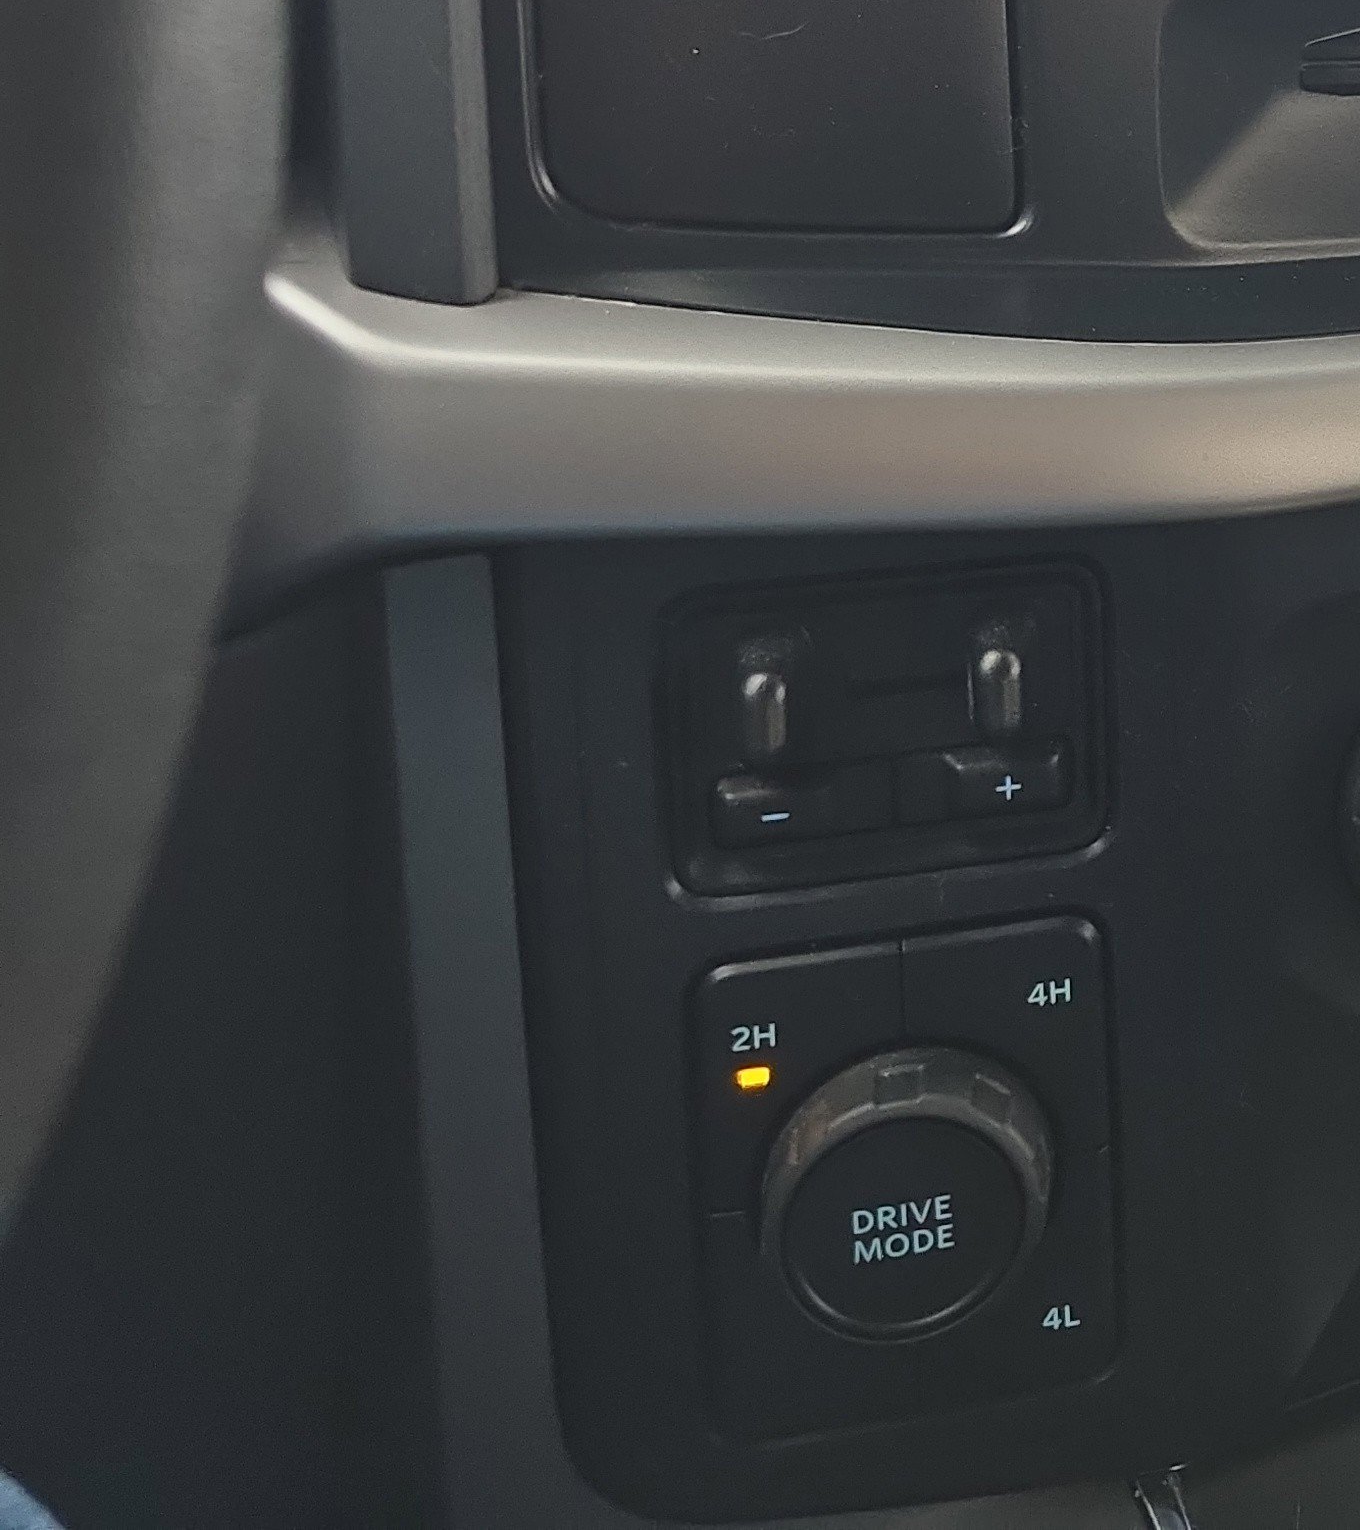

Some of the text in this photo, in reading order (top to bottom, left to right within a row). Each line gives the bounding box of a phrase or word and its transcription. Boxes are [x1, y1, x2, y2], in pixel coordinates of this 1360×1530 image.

[1027, 977, 1072, 1007] 4H
[730, 1022, 777, 1052] 2H
[852, 1193, 953, 1235] DRIVE
[853, 1223, 956, 1266] MODE
[1041, 1303, 1081, 1331] 4L
